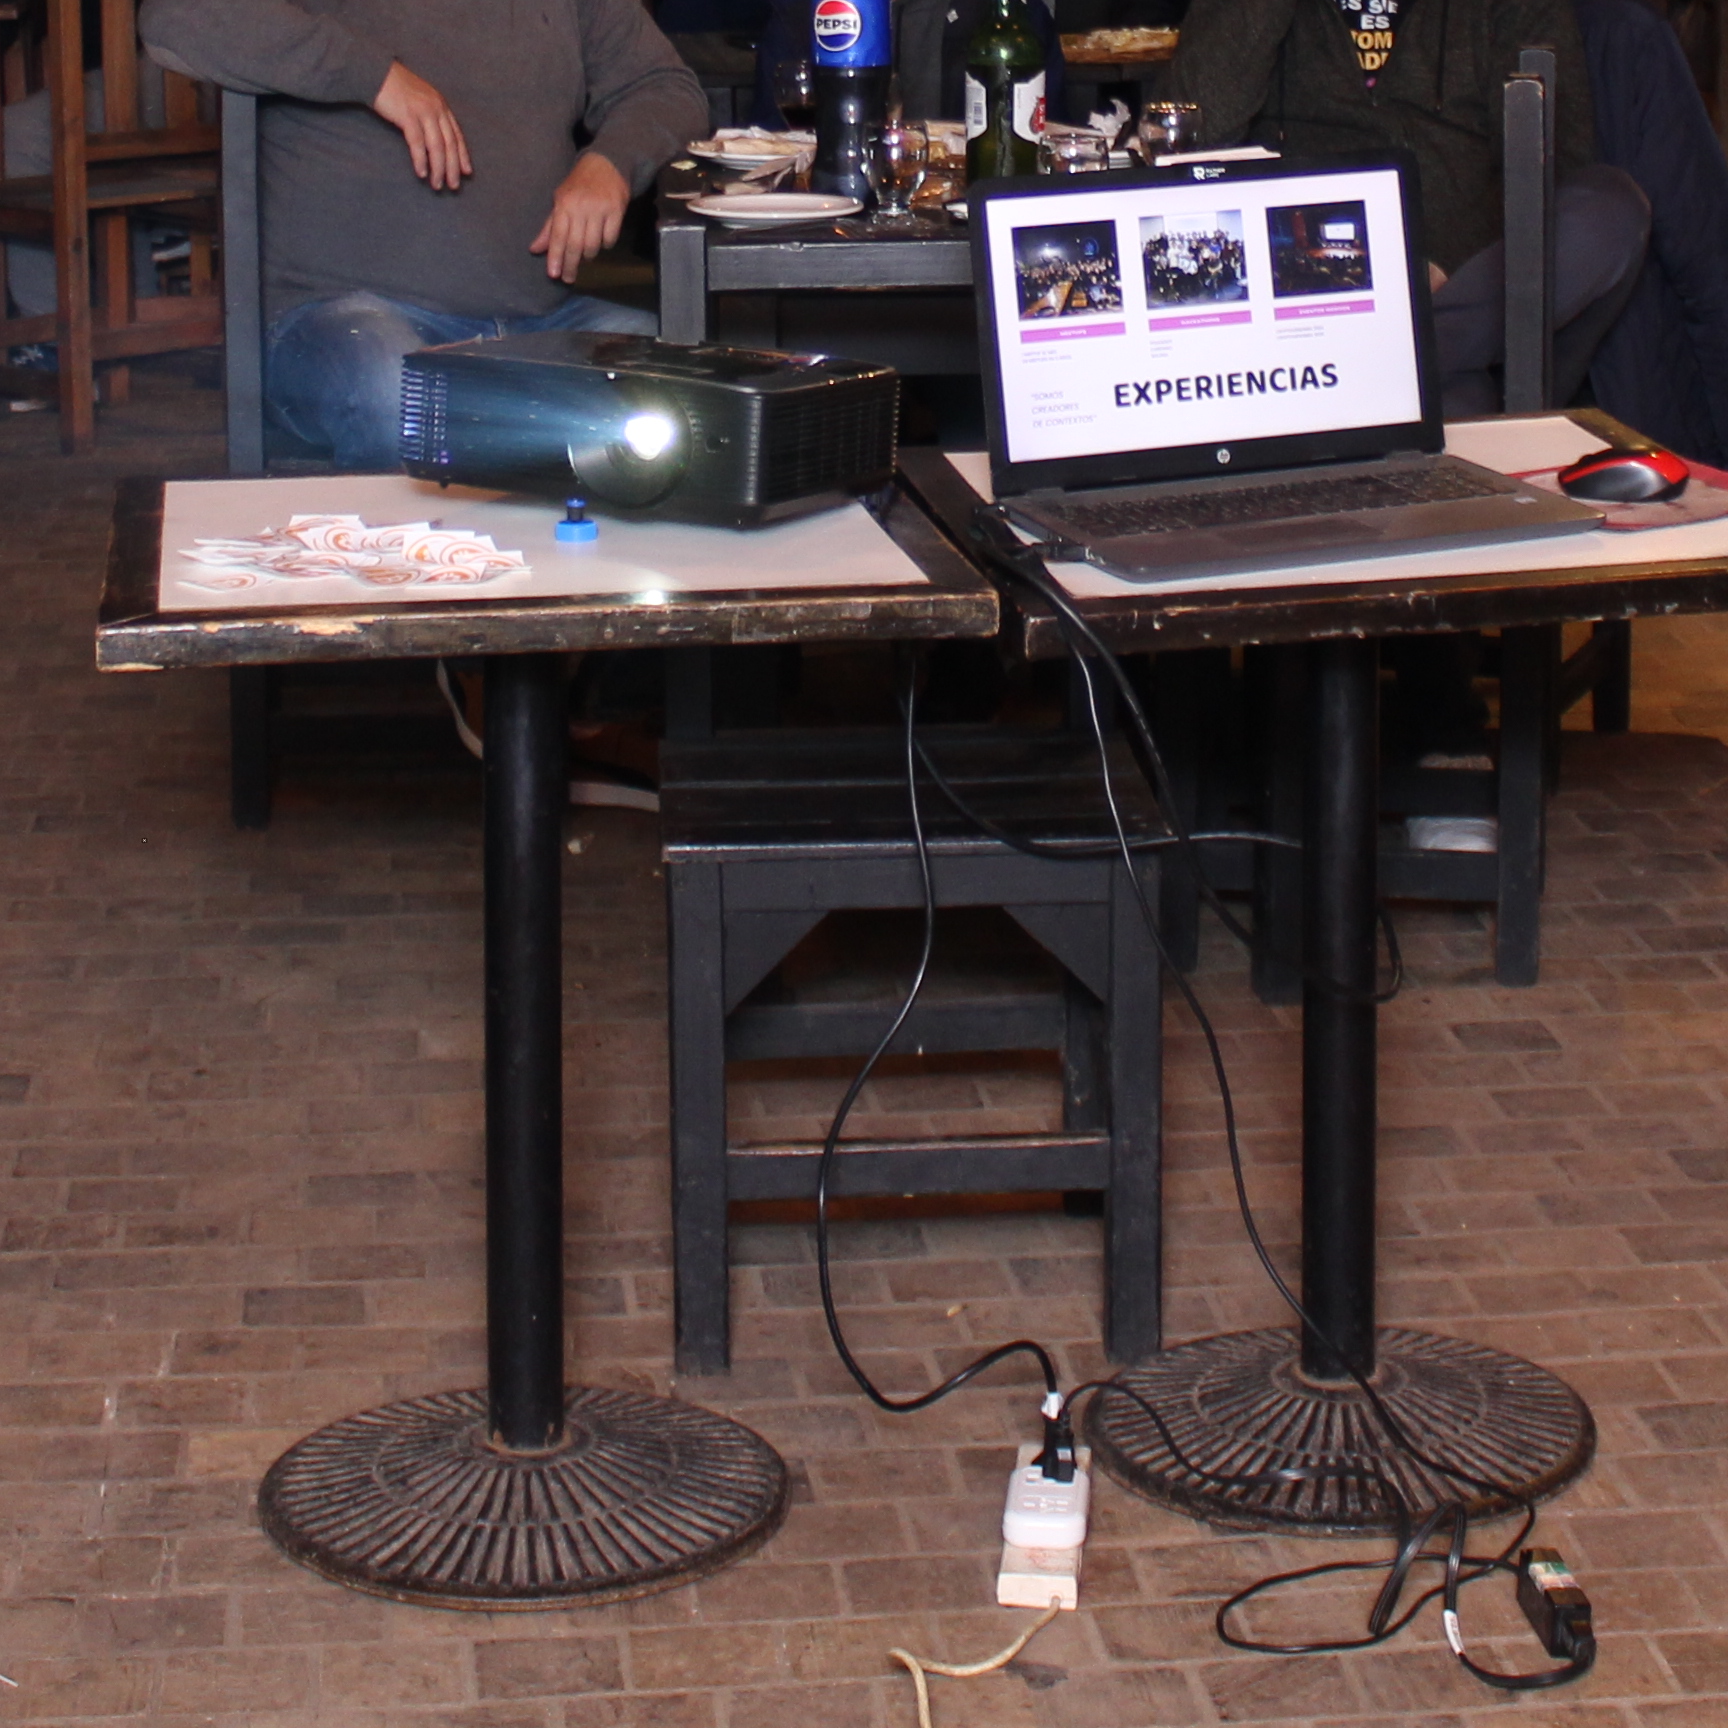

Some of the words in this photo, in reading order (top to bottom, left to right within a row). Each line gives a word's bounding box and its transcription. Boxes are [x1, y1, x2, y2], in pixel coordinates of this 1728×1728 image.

[816, 18, 857, 31] PEPSI
[1361, 14, 1390, 30] ES
[1114, 363, 1339, 408] EXPERIENCIAS
